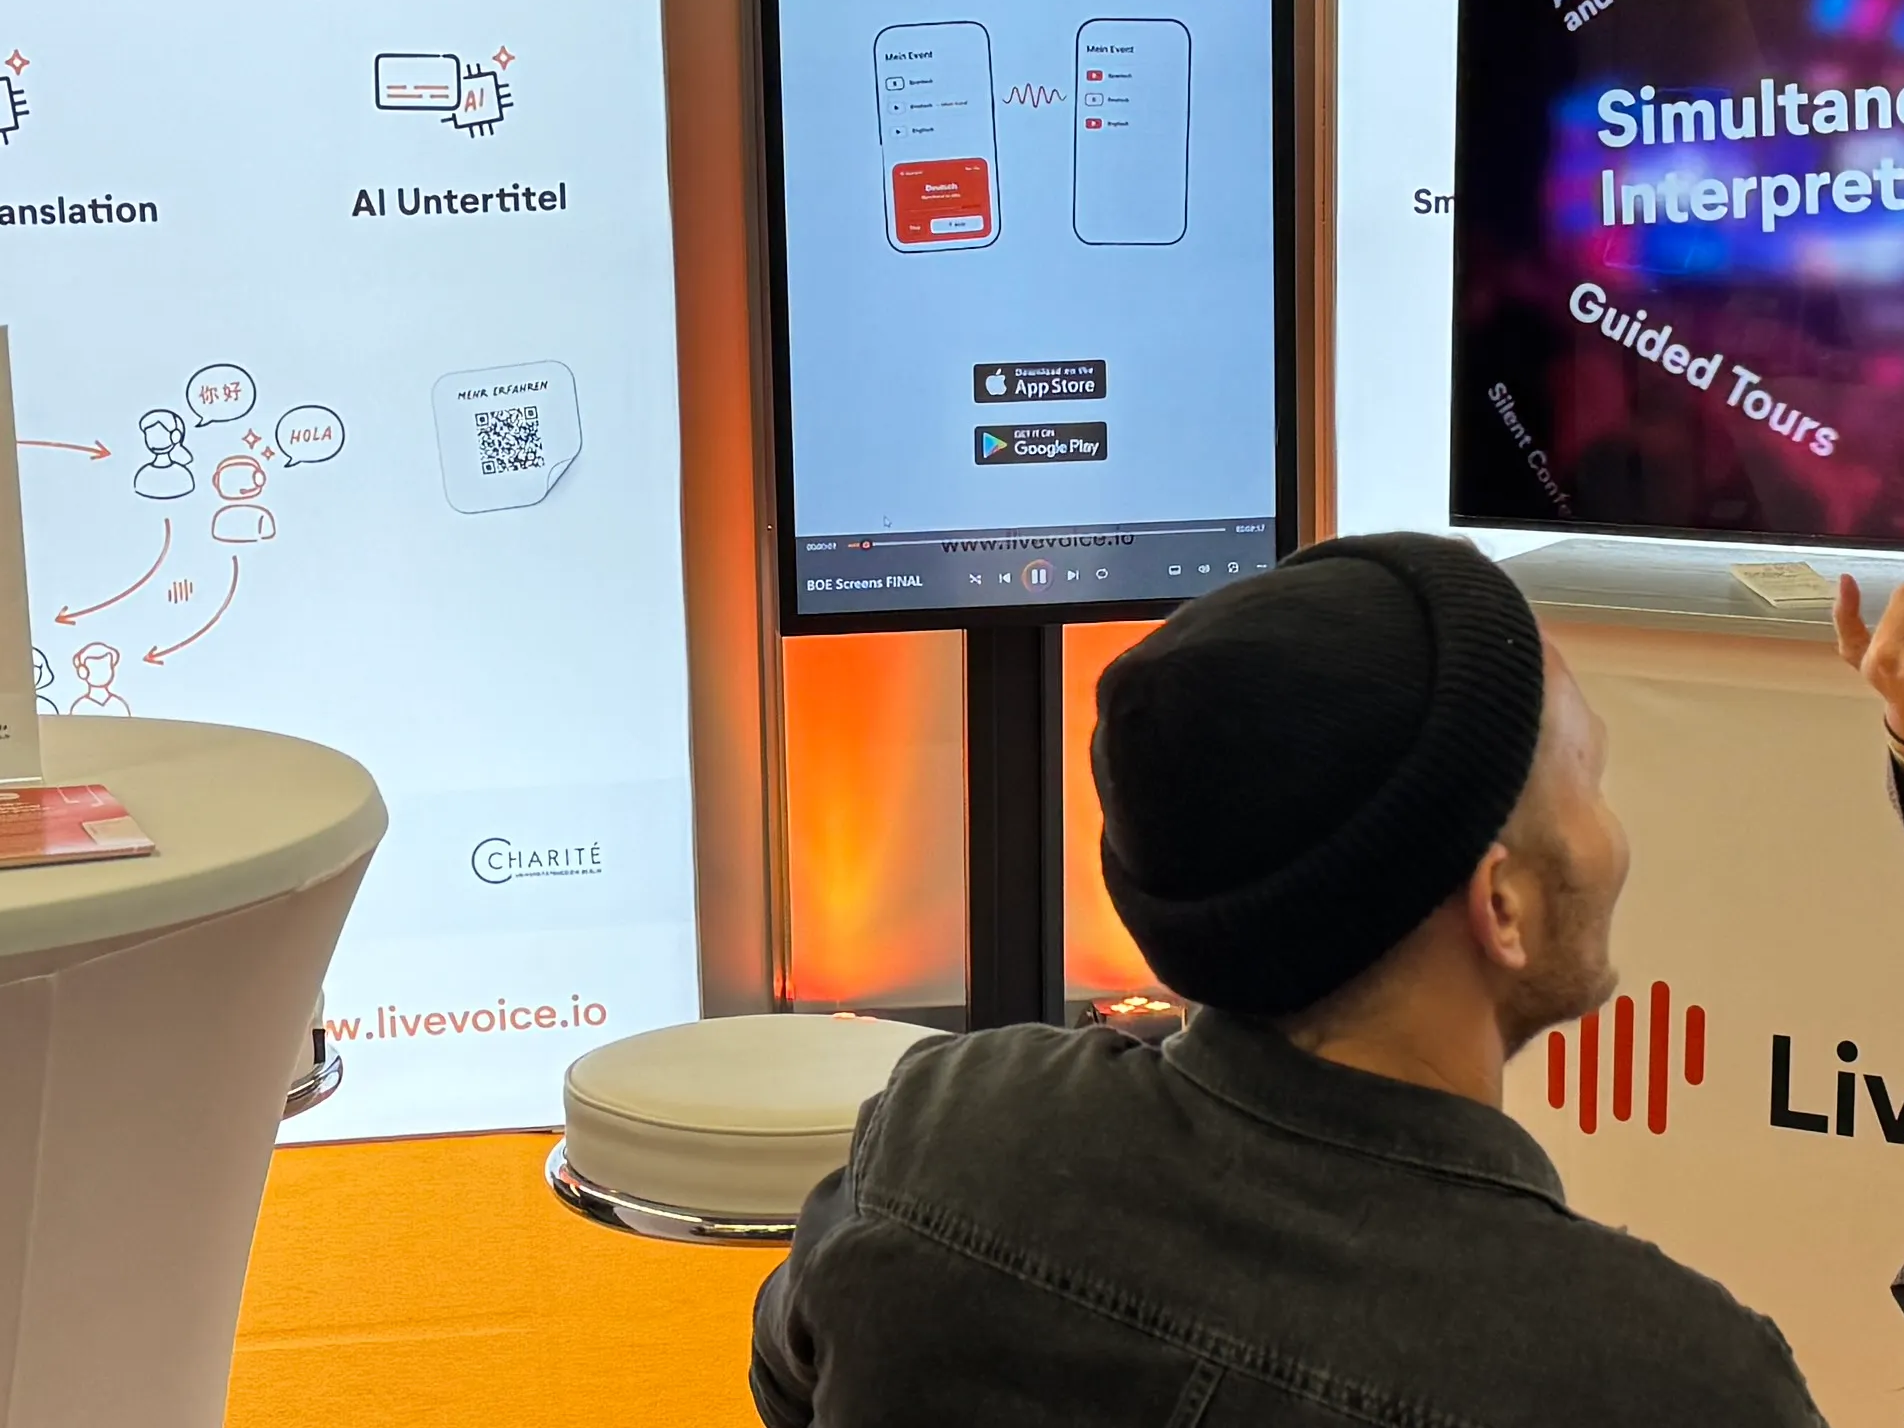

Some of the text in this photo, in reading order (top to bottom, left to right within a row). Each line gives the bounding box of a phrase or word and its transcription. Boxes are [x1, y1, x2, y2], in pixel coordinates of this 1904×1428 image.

[351, 182, 568, 218] AI Untertitel
[1568, 282, 1840, 458] Guided Tours
[457, 379, 549, 401] MEHR ERFAHREN
[1014, 377, 1096, 398] App Store
[1487, 381, 1533, 449] Silent
[289, 425, 333, 445] HOLA
[1014, 438, 1100, 458] Google Play
[806, 575, 924, 592] BOE Screens FINAL
[324, 994, 607, 1043] w.livevoice.io
